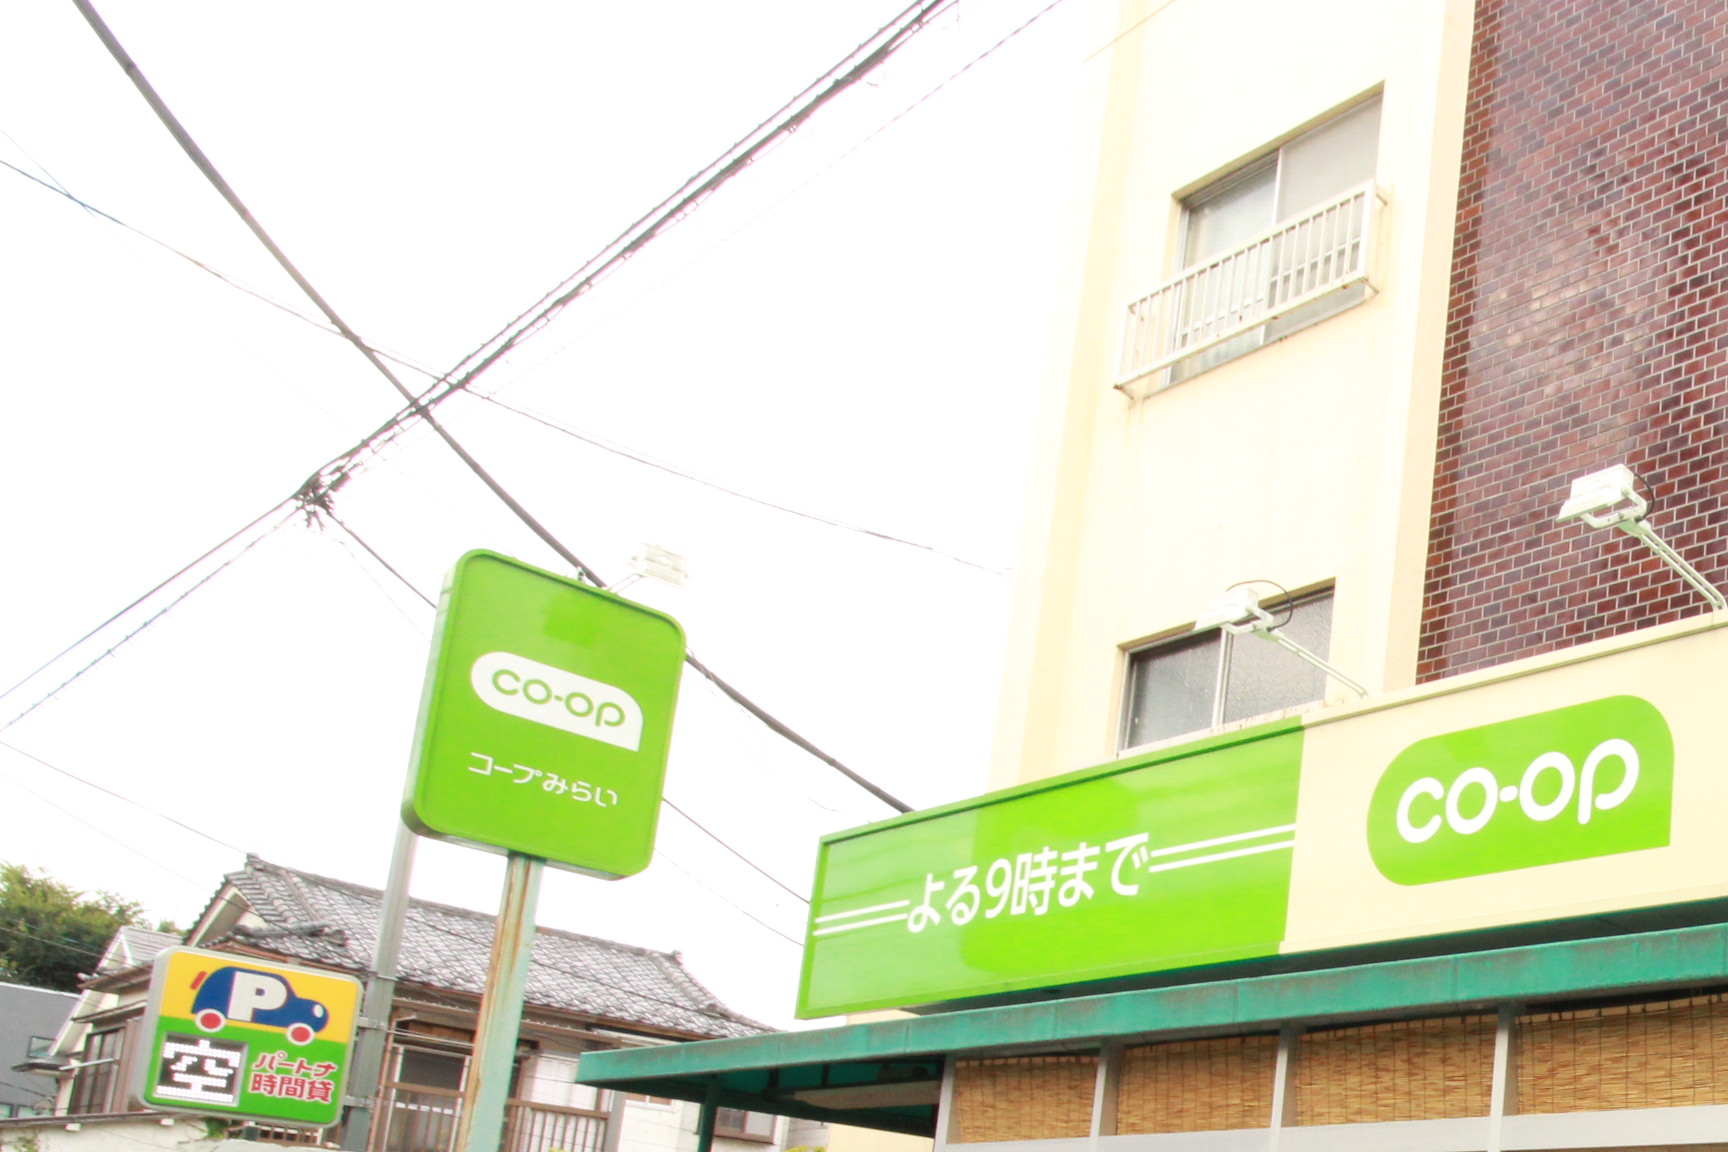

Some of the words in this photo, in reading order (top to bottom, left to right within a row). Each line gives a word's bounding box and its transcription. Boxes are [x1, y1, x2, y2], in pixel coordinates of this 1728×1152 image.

[467, 752, 618, 808] コープみらい
[906, 833, 1150, 935] よる9時まで
[227, 971, 288, 1022] P
[156, 1040, 241, 1103] 空
[250, 1074, 335, 1103] 時間貸
